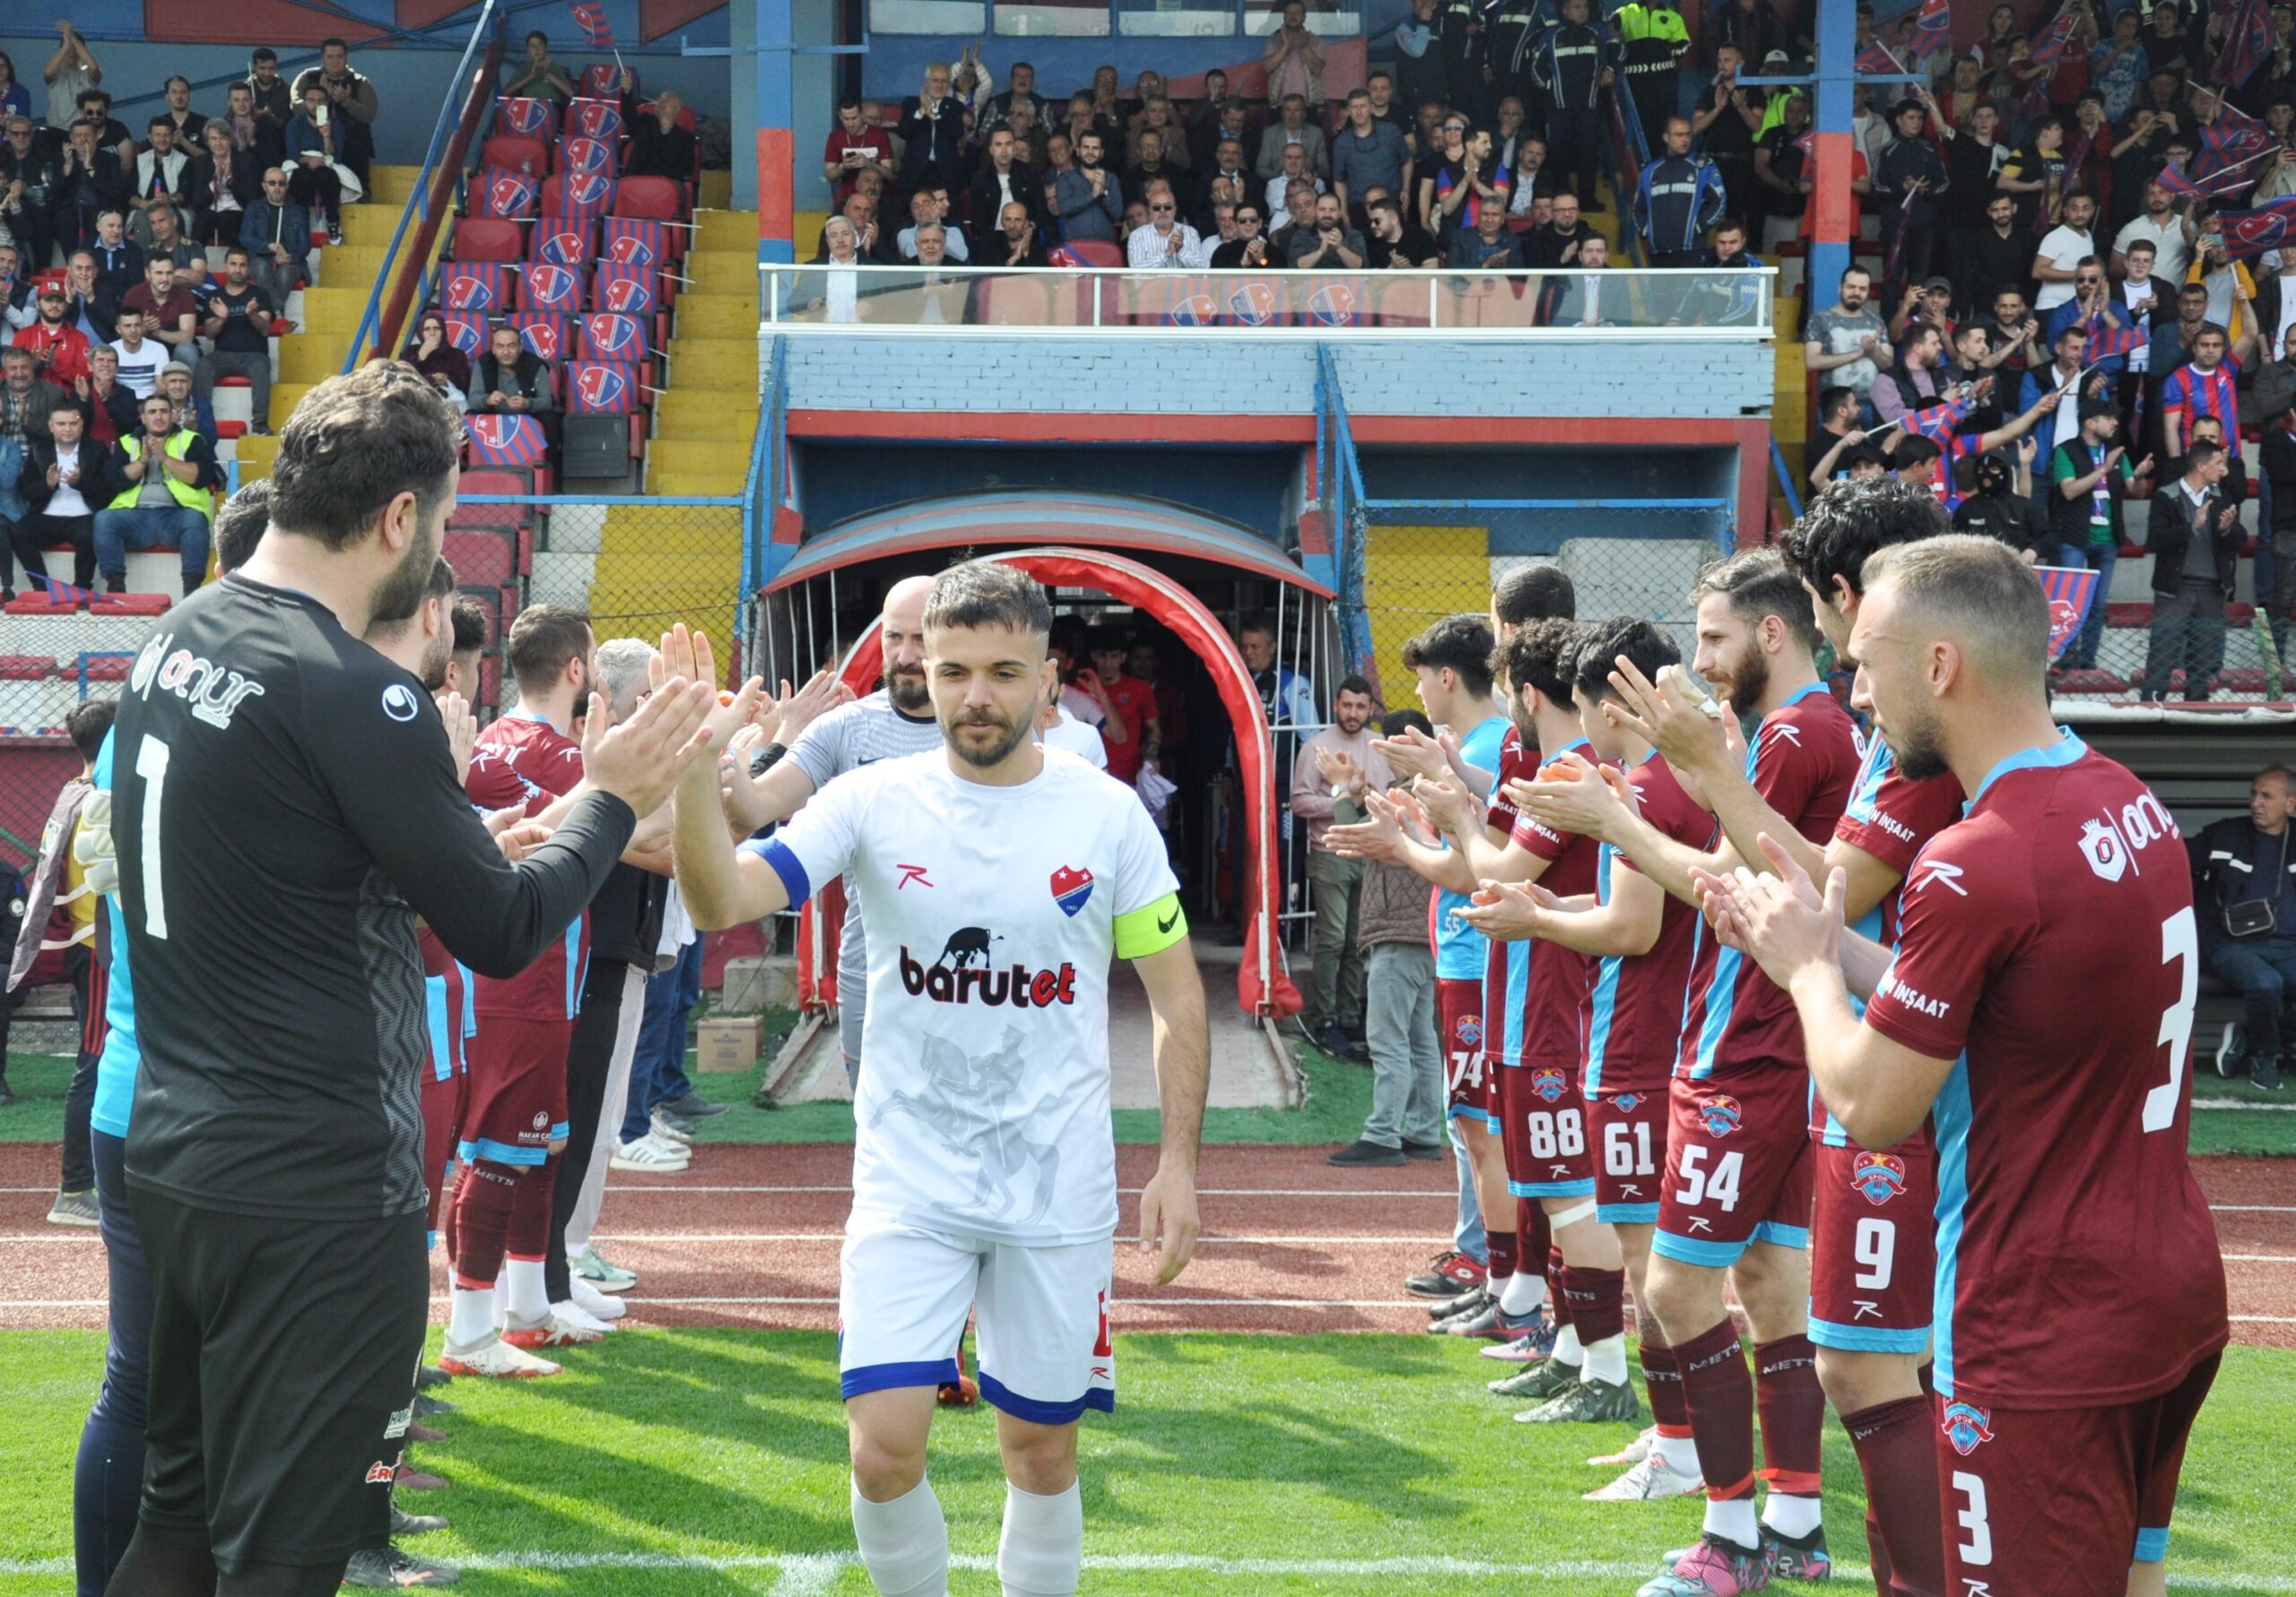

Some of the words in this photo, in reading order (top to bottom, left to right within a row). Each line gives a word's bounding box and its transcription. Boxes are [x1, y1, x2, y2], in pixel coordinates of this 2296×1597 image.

[135, 733, 170, 940] 1
[1877, 812, 1916, 843] İNŞAAT
[900, 944, 1076, 1009] barutet
[1892, 979, 1950, 1019] İNŞAAT
[2141, 905, 2199, 1133] 3
[1450, 1051, 1483, 1091] 74
[517, 1131, 540, 1139] HAKAN
[1527, 1108, 1585, 1159] 88
[1605, 1121, 1656, 1176] 61
[1675, 1143, 1744, 1212] 54
[1854, 1217, 1896, 1290] 9
[1952, 1470, 1992, 1566] 3
